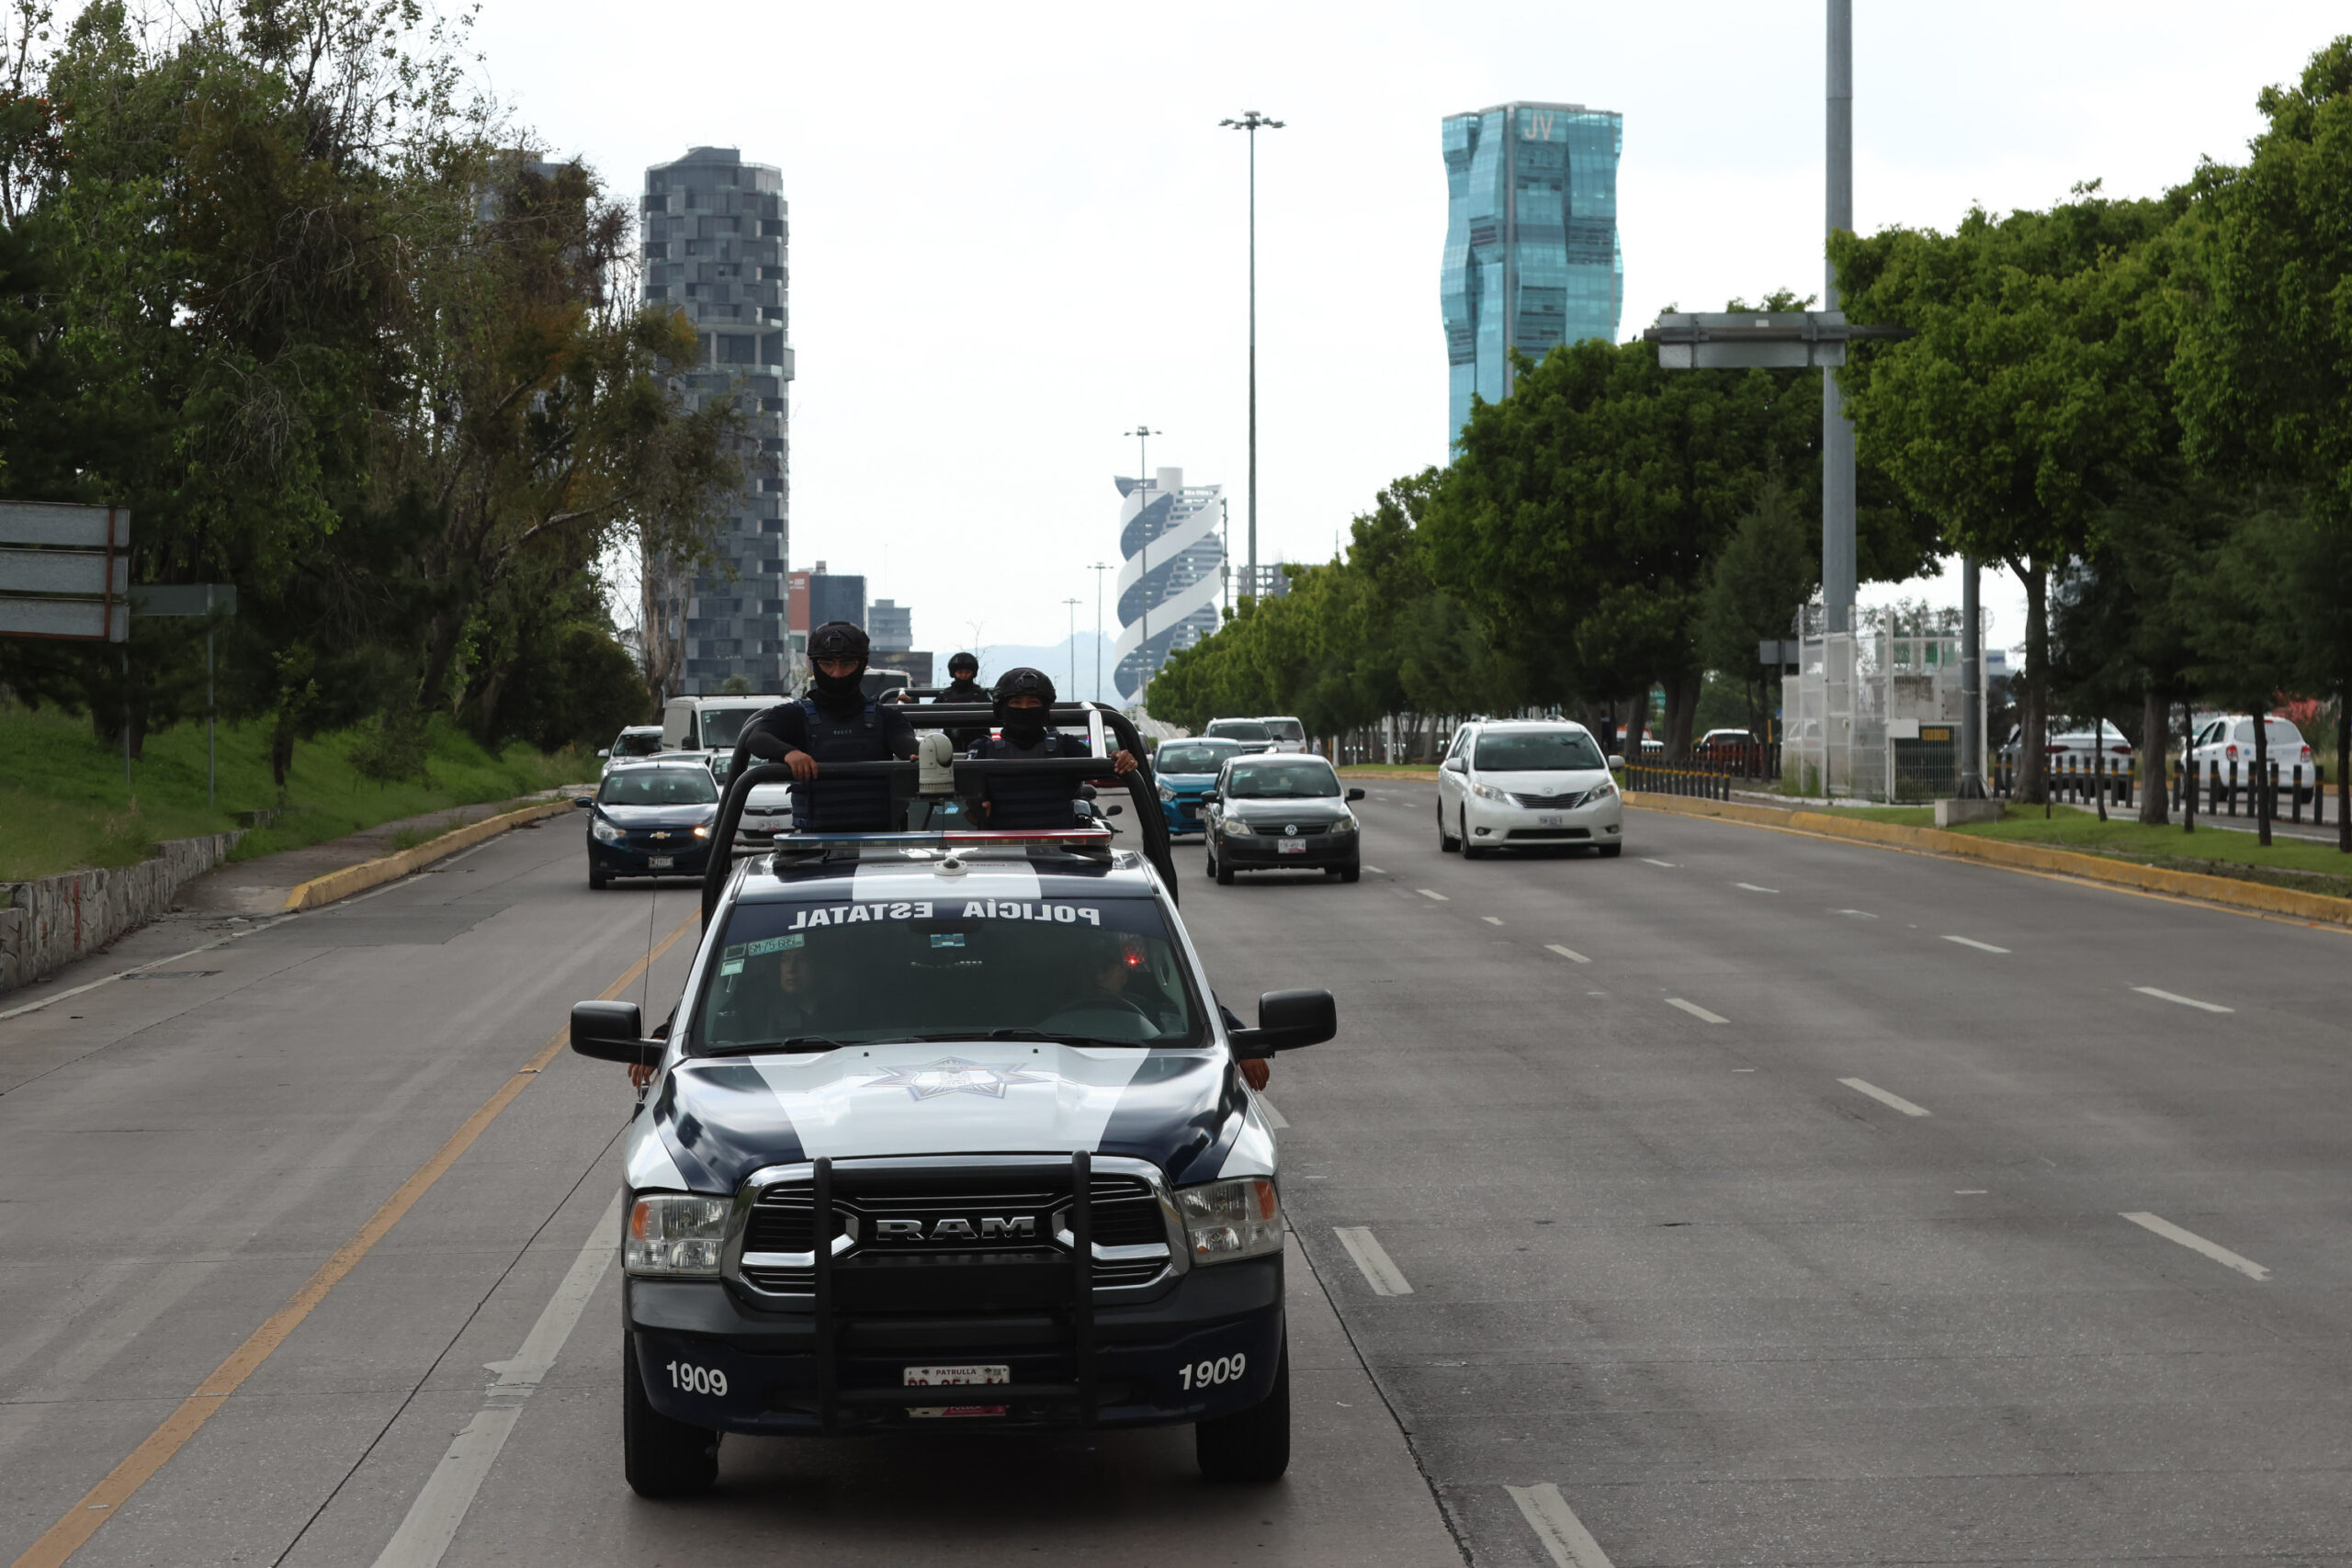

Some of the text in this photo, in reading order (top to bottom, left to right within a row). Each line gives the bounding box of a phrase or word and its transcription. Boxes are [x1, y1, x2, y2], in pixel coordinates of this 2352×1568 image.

[1524, 114, 1555, 141] JV
[876, 1215, 1035, 1241] RAM
[666, 1359, 728, 1396] 1909
[1179, 1352, 1246, 1391] 1909
